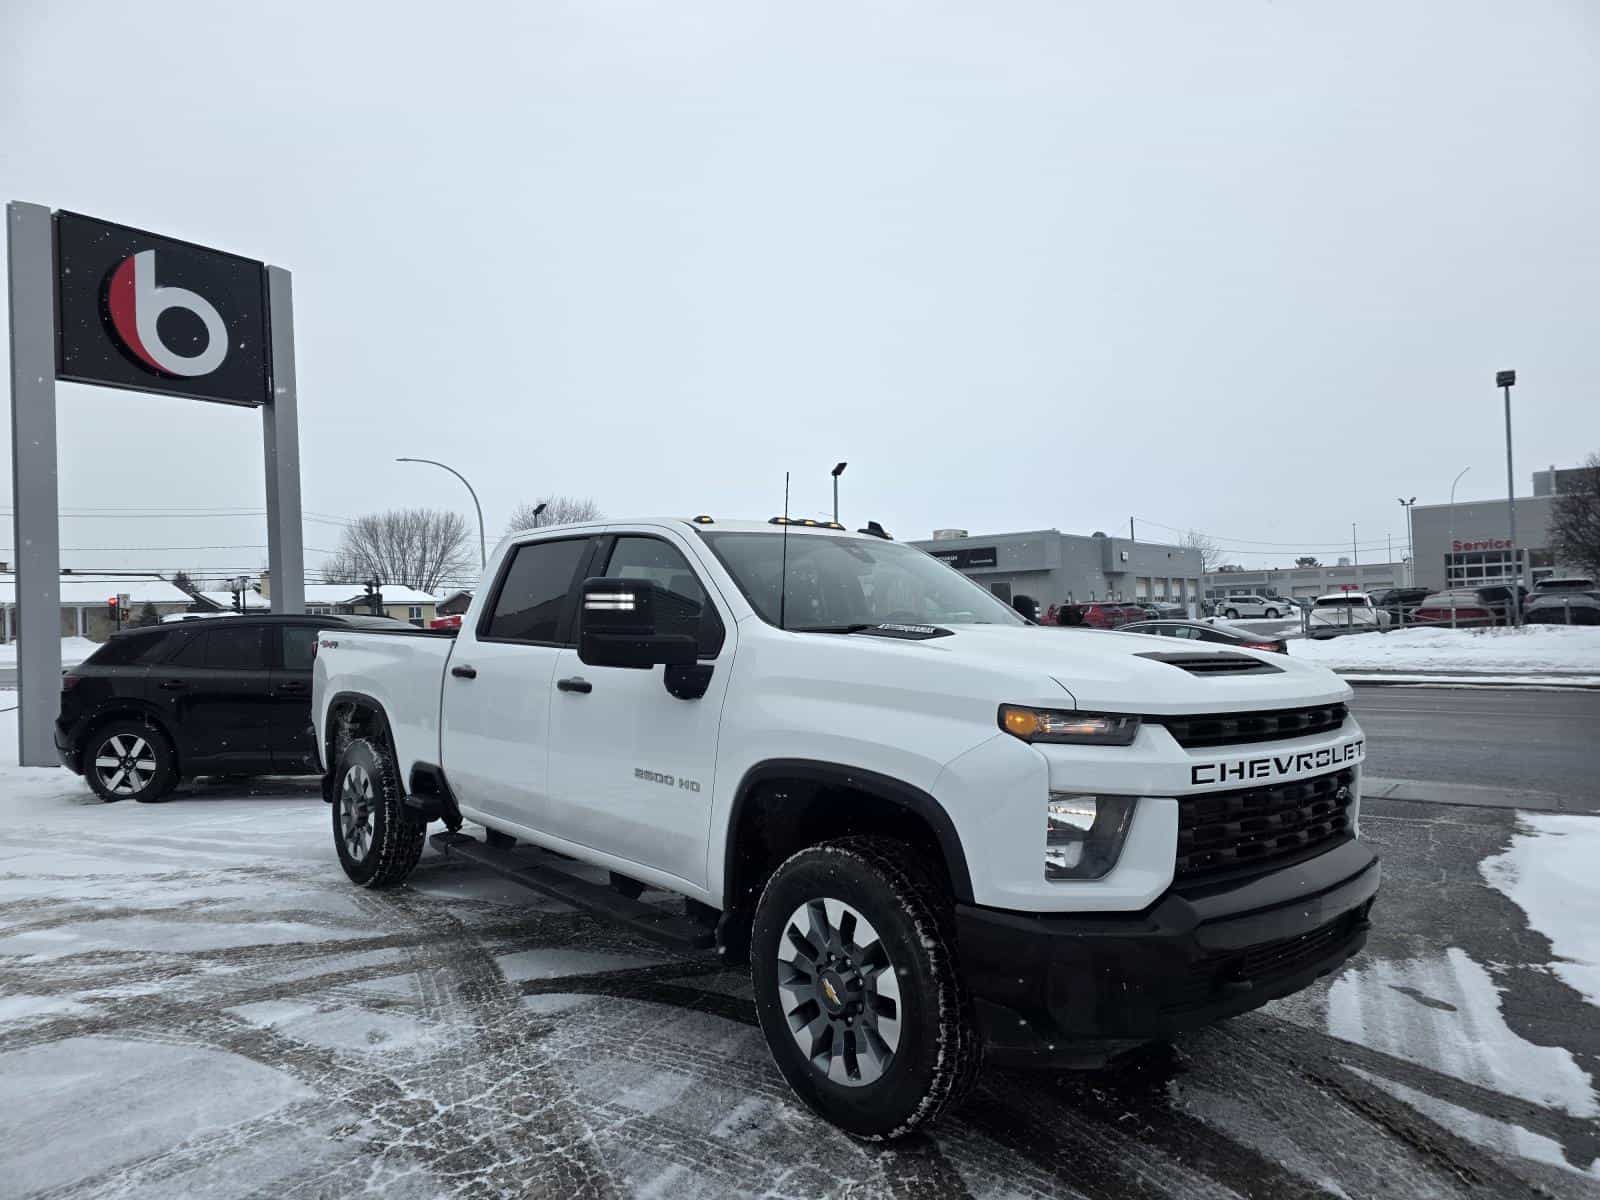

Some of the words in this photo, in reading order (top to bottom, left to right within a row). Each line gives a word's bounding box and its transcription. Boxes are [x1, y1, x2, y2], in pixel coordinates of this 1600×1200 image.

[634, 767, 675, 787] 2500
[678, 777, 701, 793] HD
[1191, 740, 1363, 785] CHEVROLET
